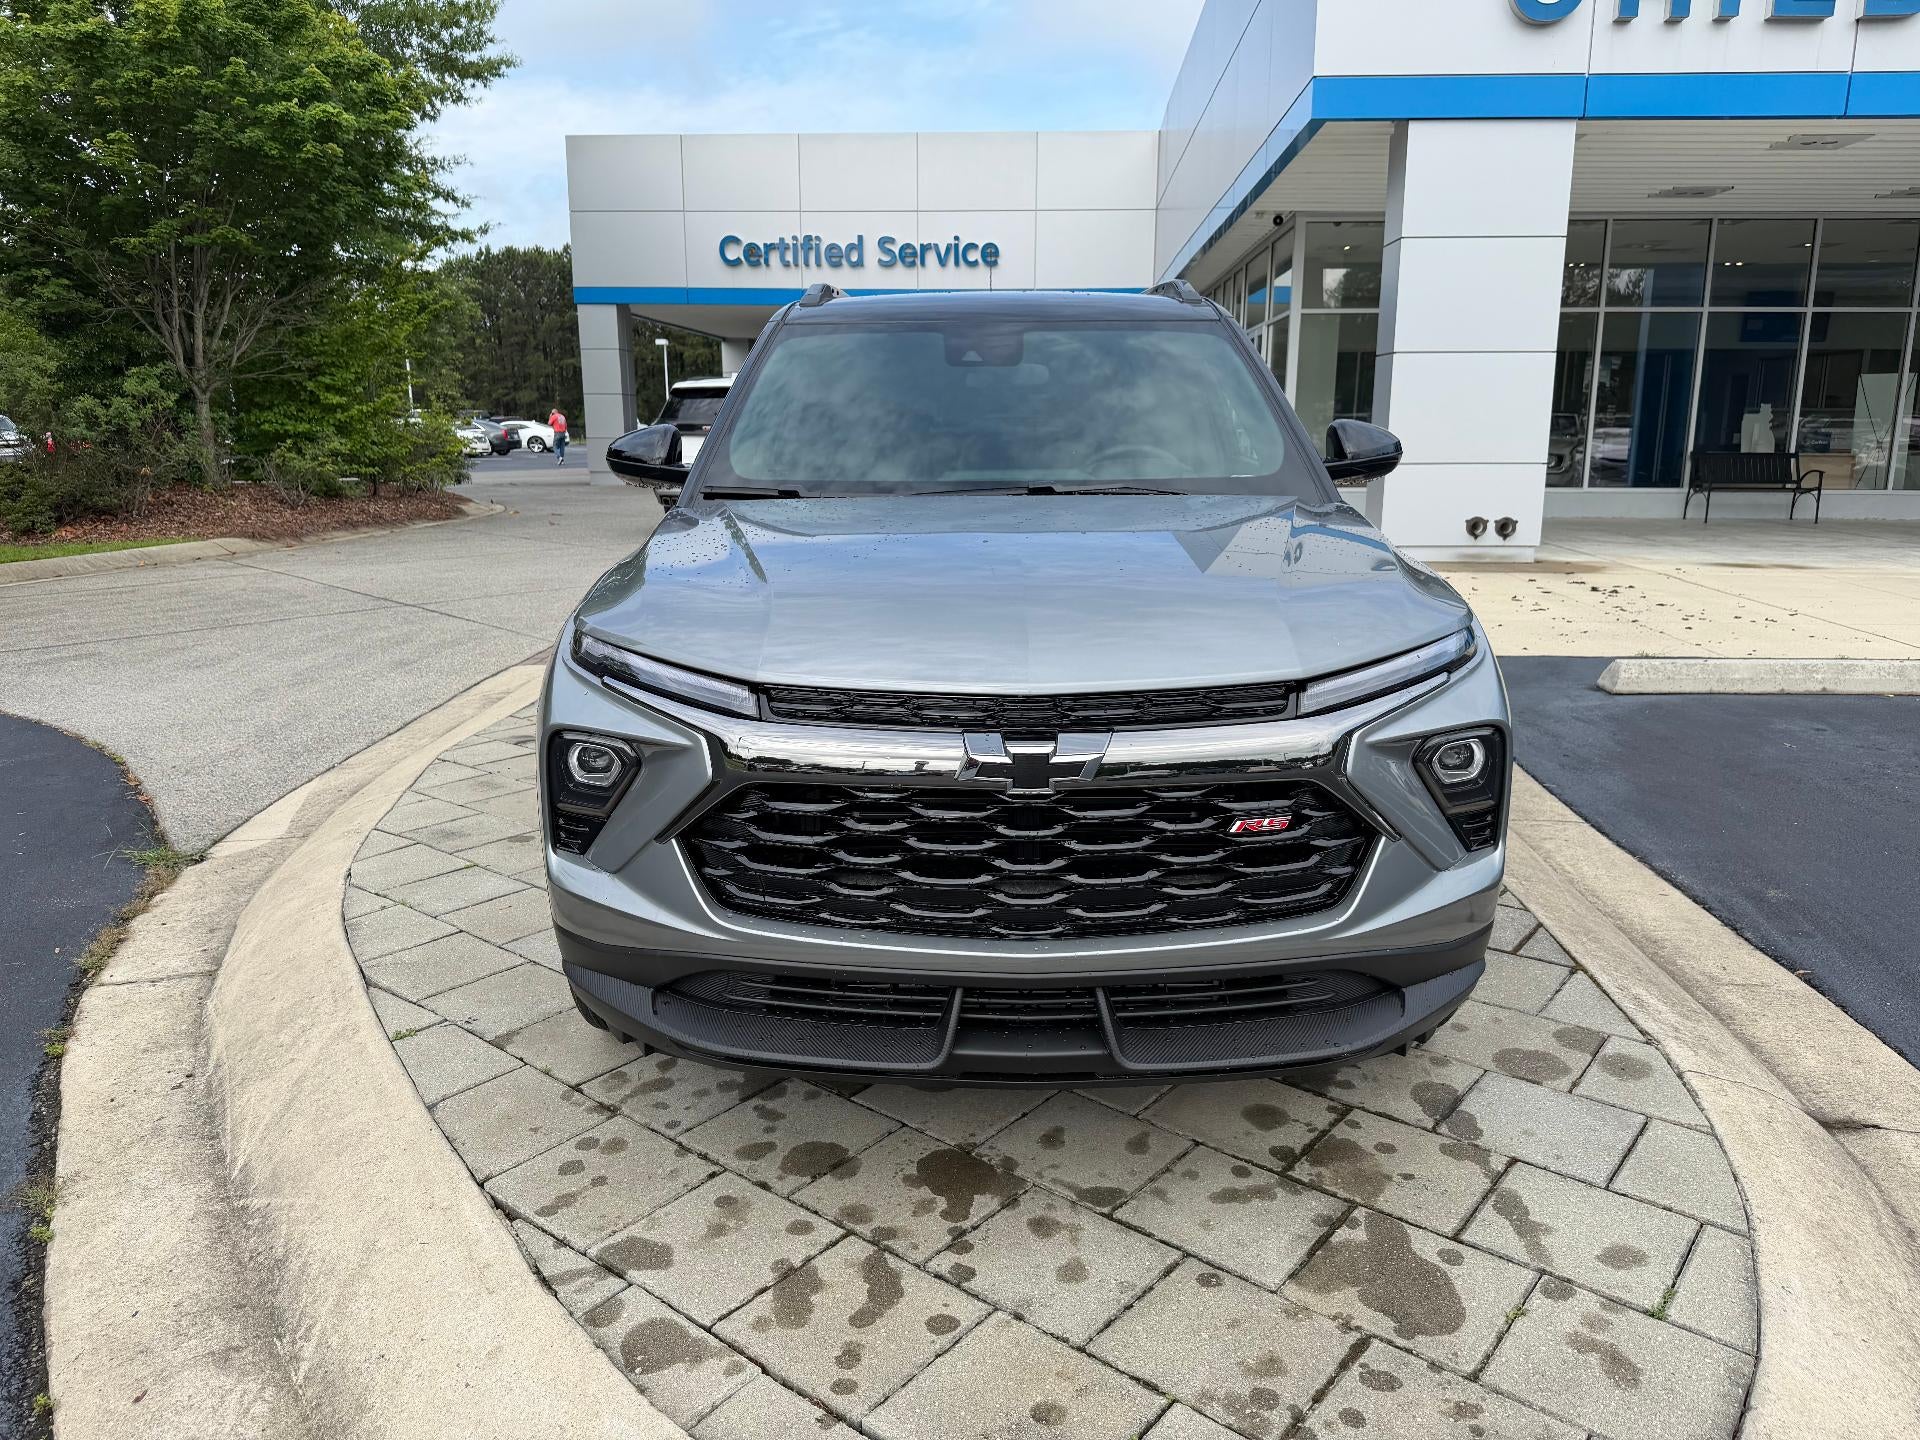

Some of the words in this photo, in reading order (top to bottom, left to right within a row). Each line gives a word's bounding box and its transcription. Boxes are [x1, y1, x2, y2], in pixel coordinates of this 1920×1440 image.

[718, 234, 865, 268] Certified
[877, 235, 1000, 268] Service
[1229, 815, 1292, 833] RS
